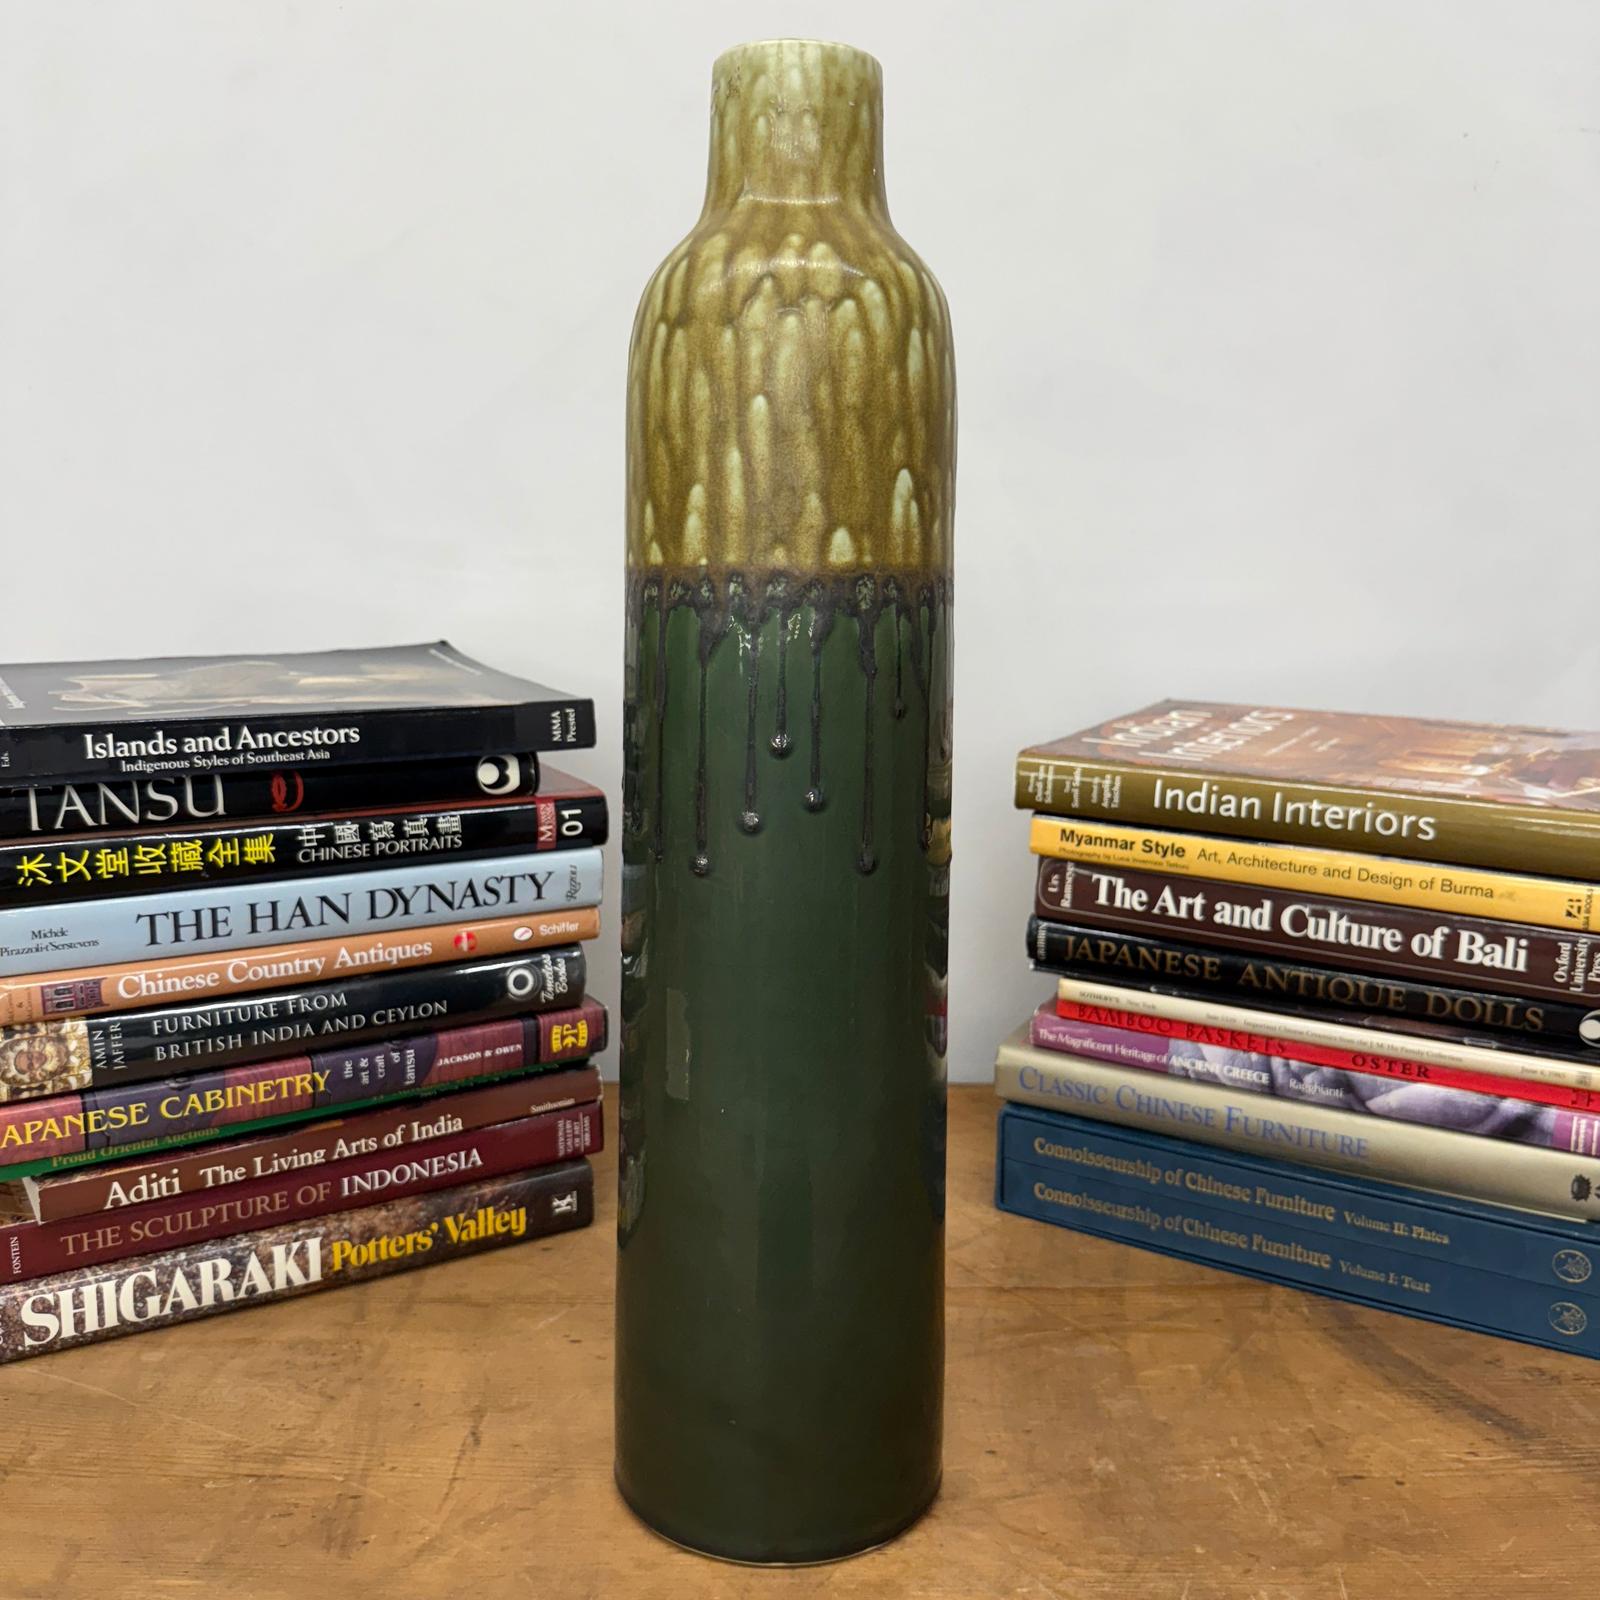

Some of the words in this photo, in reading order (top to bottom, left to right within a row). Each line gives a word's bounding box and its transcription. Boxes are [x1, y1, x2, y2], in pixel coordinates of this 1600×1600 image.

[84, 730, 177, 759] Islands
[183, 726, 232, 753] and
[237, 725, 360, 750] Ancestors
[551, 710, 562, 742] MMA
[565, 708, 577, 742] Prestel
[121, 758, 190, 774] Indigenous
[193, 754, 230, 769] Styles
[231, 753, 245, 764] of
[247, 750, 305, 764] Southeast
[307, 749, 331, 760] Asia
[11, 774, 227, 831] TANSU
[561, 808, 583, 837] 01
[1152, 779, 1261, 820] Indian
[1272, 791, 1437, 841] Interiors
[16, 833, 276, 886] 沐文堂收藏全集
[298, 843, 370, 863] CHINESE
[374, 834, 462, 856] PORTRAITS
[1059, 829, 1136, 851] Myanmar
[1142, 839, 1186, 858] Style
[1197, 849, 1221, 864] Art,
[1226, 852, 1317, 875] Architecture
[1323, 865, 1351, 881] and
[1358, 868, 1413, 889] Design
[1419, 874, 1435, 891] of
[1440, 879, 1494, 899] Burma
[136, 906, 233, 947] THE
[247, 892, 352, 934] HAN
[366, 871, 554, 920] DYNASTY
[539, 921, 579, 936] Schiffer
[1092, 873, 1148, 912] The
[1151, 885, 1206, 922] Art
[1213, 899, 1272, 931] and
[1280, 903, 1403, 953] Culture
[1411, 926, 1449, 960] of
[1454, 929, 1528, 972] Bali
[117, 971, 220, 999] Chinese
[227, 957, 325, 984] Country
[334, 941, 433, 968] Antiques
[1553, 942, 1572, 983] Oxford
[1569, 936, 1591, 992] University
[1588, 952, 1600, 982] Press
[1064, 936, 1221, 981] JAPANESE
[1239, 964, 1407, 1009] ANTIQUE
[1427, 994, 1544, 1032] DOLLS
[152, 1001, 278, 1036] FURNITURE
[288, 993, 347, 1016] FROM
[155, 1034, 242, 1062] BRITISH
[253, 1021, 315, 1046] INDIA
[323, 1013, 366, 1034] AND
[373, 1000, 448, 1026] CEYLON
[92, 1029, 107, 1069] AMIN
[110, 1022, 127, 1070] JAFFER
[392, 1048, 401, 1063] of
[437, 1051, 482, 1066] JACKSON
[485, 1048, 492, 1057] &
[495, 1044, 522, 1056] OWEN
[1039, 1028, 1056, 1041] The
[1057, 1031, 1113, 1053] Magnificent
[1115, 1043, 1156, 1064] Heritage
[1156, 1052, 1168, 1064] of
[1169, 1054, 1220, 1073] ANCIENT
[1224, 1064, 1270, 1084] GREECE
[1077, 1003, 1173, 1033] BAMBOO
[1184, 1026, 1286, 1054] BASKETS
[1352, 1054, 1430, 1078] OSTER
[343, 1059, 354, 1079] the
[361, 1057, 370, 1069] &
[361, 1071, 370, 1085] art
[376, 1054, 386, 1078] craft
[403, 1048, 416, 1085] tansu
[1018, 1066, 1107, 1104] CLASSIC
[0, 1102, 149, 1148] APANESE
[160, 1070, 332, 1119] CABINETRY
[52, 1151, 96, 1167] Proud
[100, 1138, 159, 1157] Oriental
[163, 1126, 220, 1145] Auctions
[103, 1168, 182, 1209] Aditi
[199, 1163, 246, 1188] The
[252, 1149, 326, 1178] Living
[333, 1136, 377, 1161] Arts
[384, 1124, 404, 1147] of
[411, 1114, 463, 1141] India
[60, 1227, 122, 1256] THE
[130, 1190, 290, 1241] SCULPTURE
[296, 1181, 332, 1204] OF
[341, 1149, 484, 1197] INDONESIA
[1033, 1137, 1161, 1184] Connoisseurship
[1163, 1167, 1184, 1185] of
[1185, 1172, 1250, 1201] Chinese
[1255, 1187, 1335, 1221] Furniture
[1344, 1211, 1390, 1233] Volume
[1411, 1226, 1449, 1244] Plates
[10, 1235, 21, 1275] FONTEIN
[1033, 1182, 1161, 1231] Connoisseurship
[1163, 1215, 1182, 1232] of
[1183, 1217, 1249, 1249] Chinese
[1252, 1234, 1331, 1268] Furniture
[1338, 1260, 1384, 1282] Volume
[1401, 1276, 1431, 1292] Text
[20, 1237, 323, 1347] SHIGARAKI
[331, 1222, 438, 1271] Potters'
[444, 1205, 526, 1243] Valley
